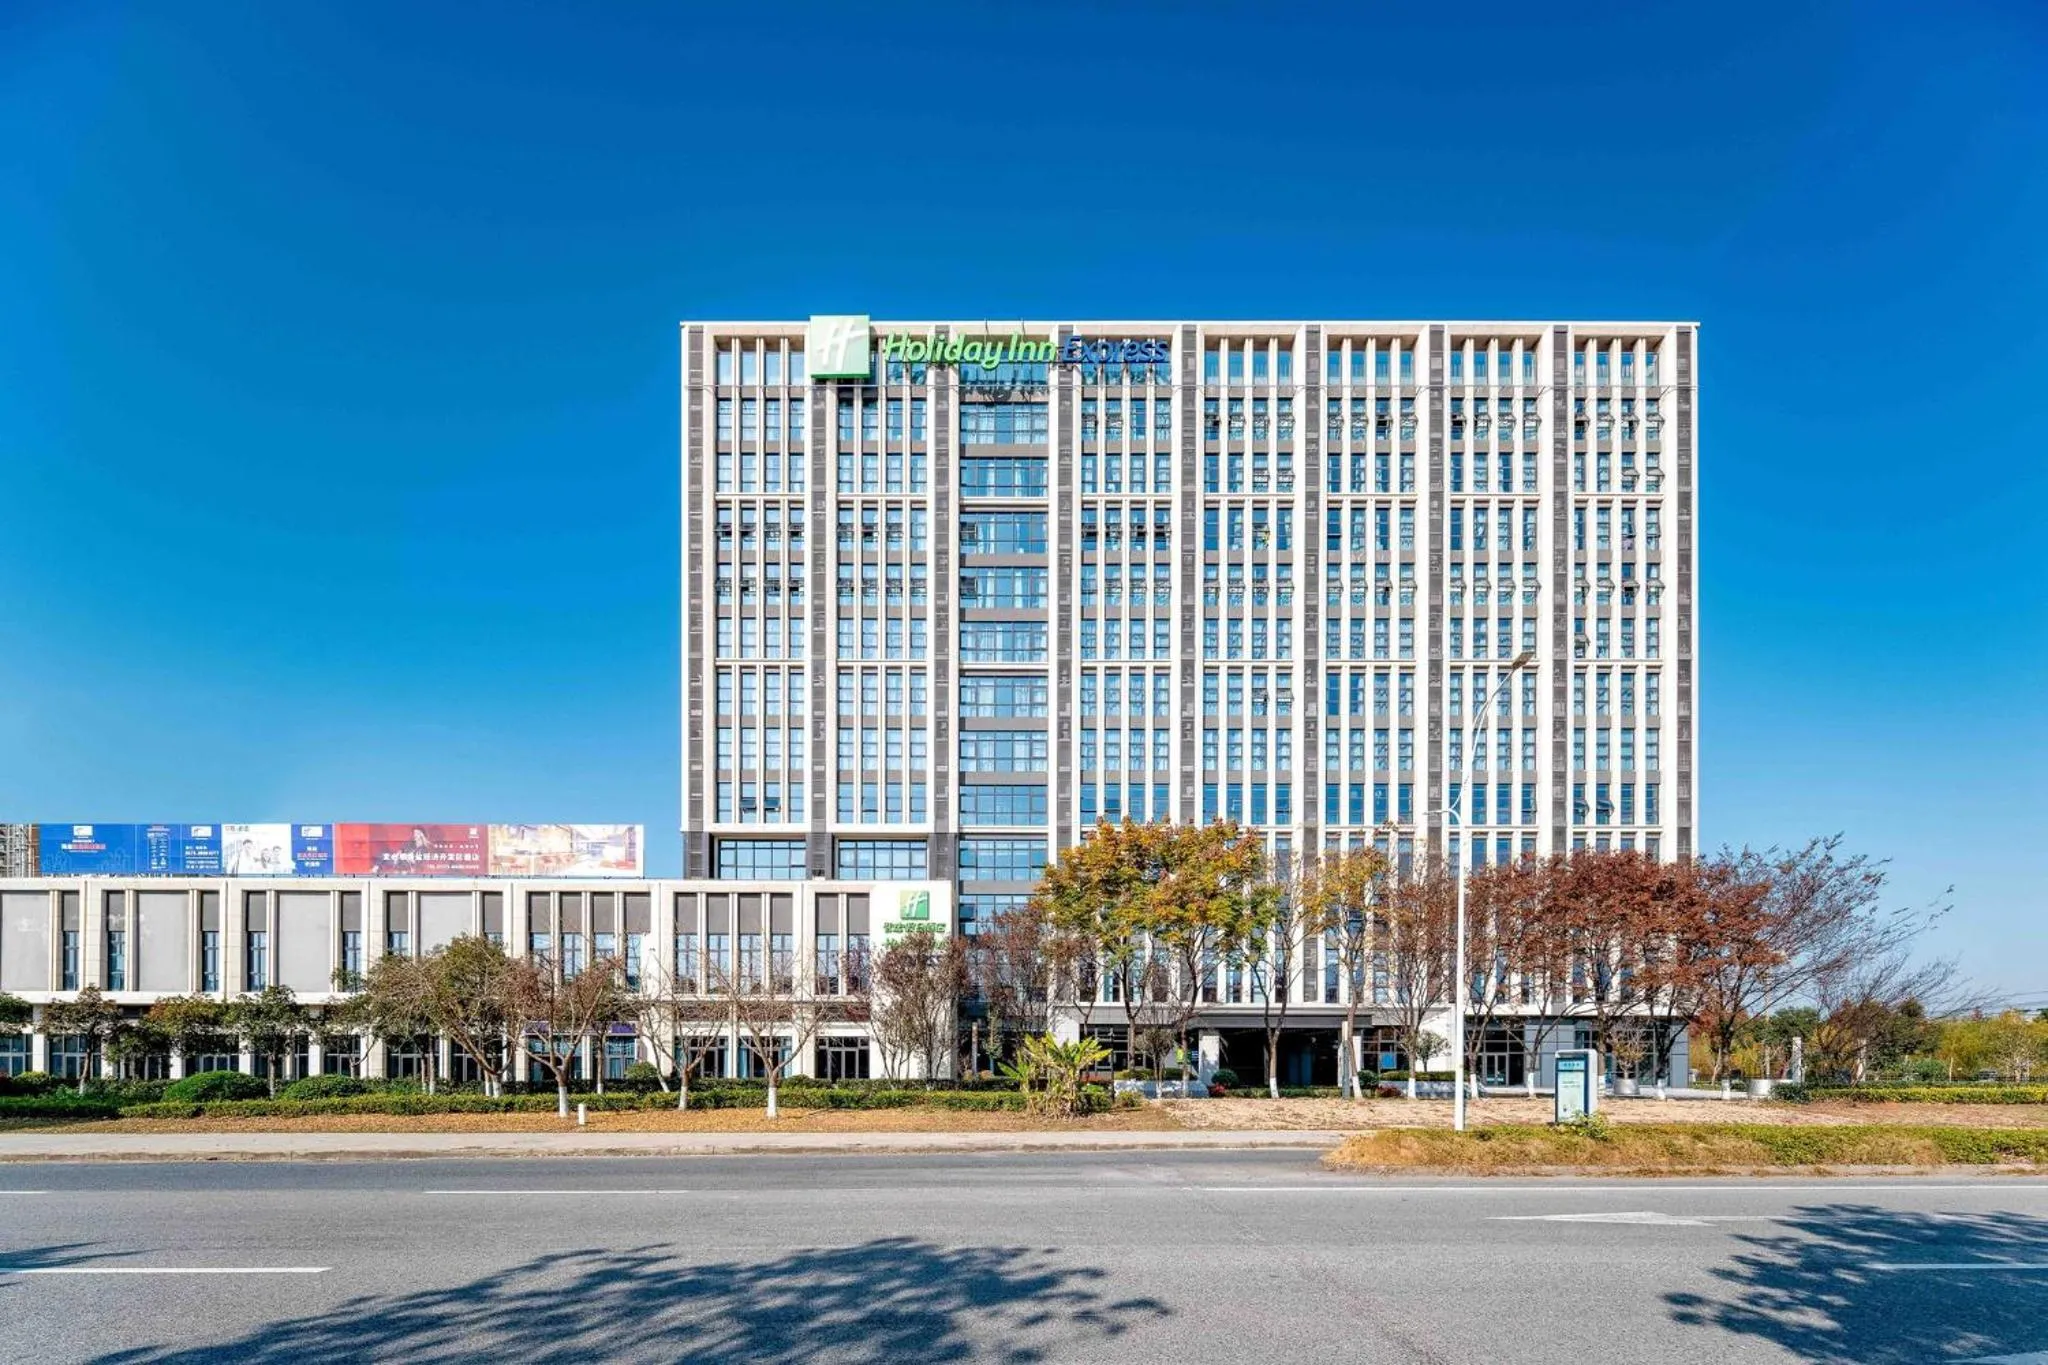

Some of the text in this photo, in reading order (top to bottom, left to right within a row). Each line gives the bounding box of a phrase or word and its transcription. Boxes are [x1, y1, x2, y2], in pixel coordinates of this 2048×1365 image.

[884, 330, 1169, 370] Holiday Inn Express
